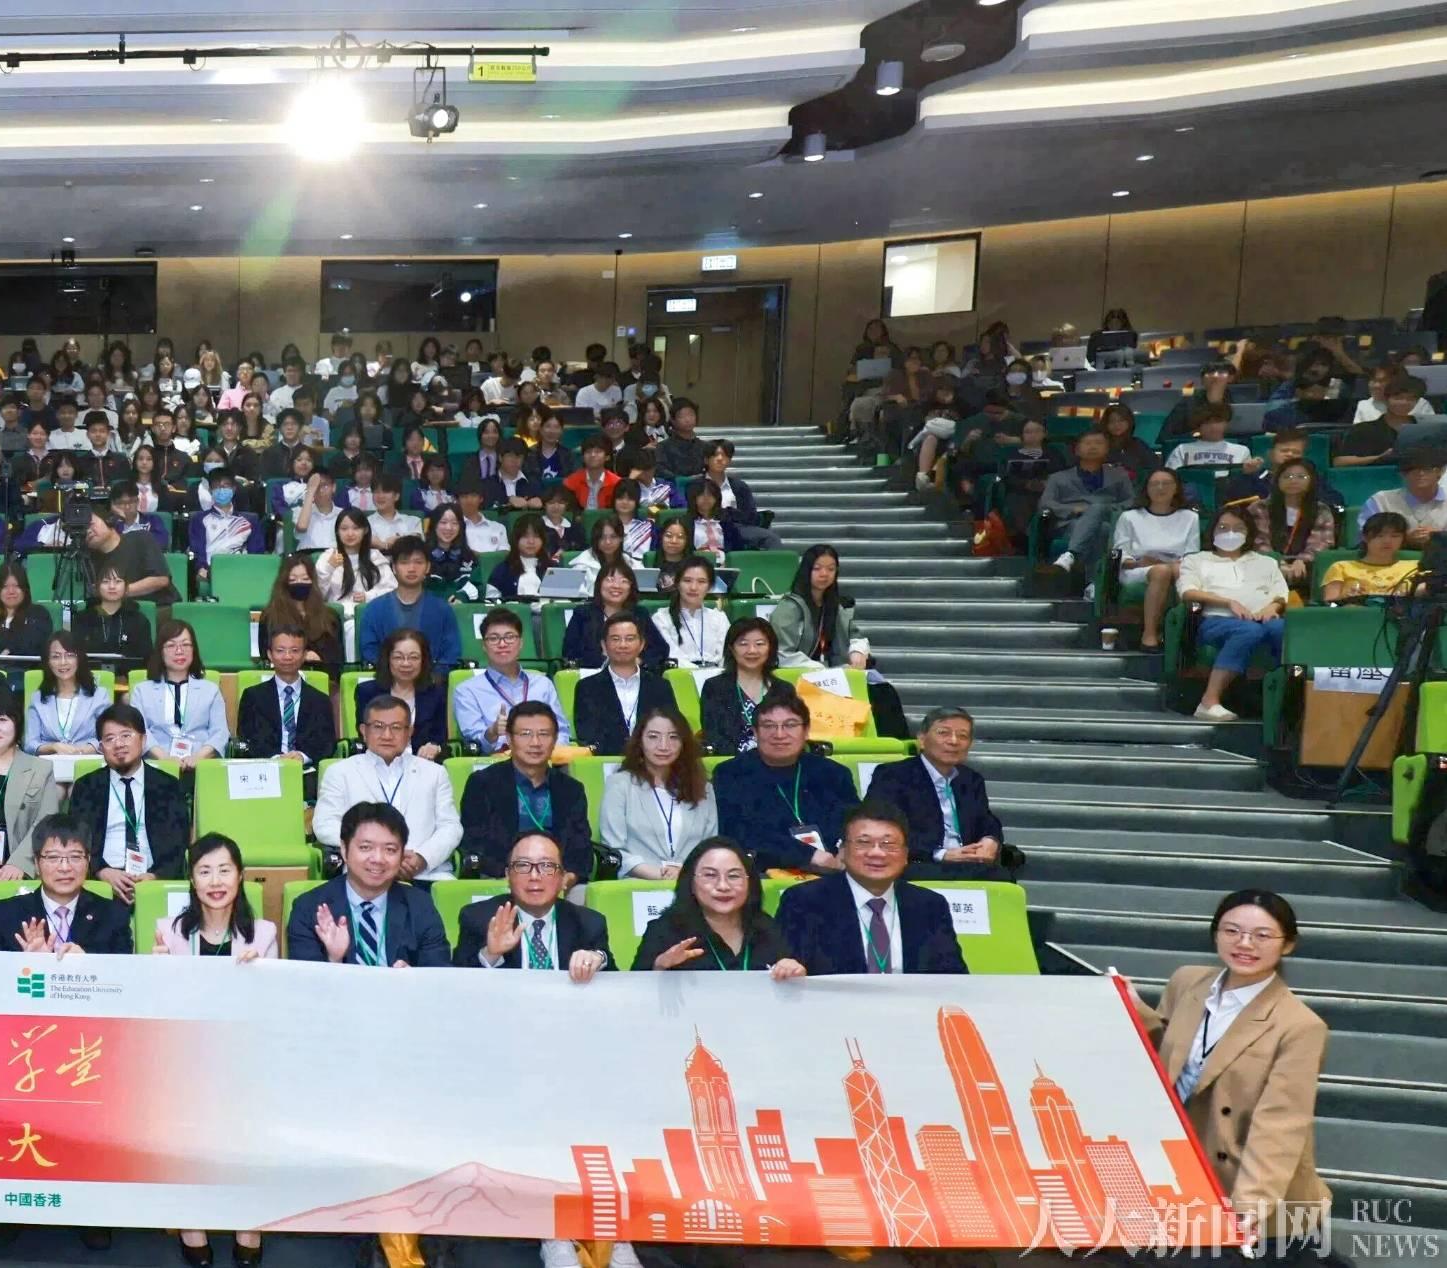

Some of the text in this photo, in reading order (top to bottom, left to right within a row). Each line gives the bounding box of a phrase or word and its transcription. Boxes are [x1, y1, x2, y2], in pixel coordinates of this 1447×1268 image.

[477, 65, 484, 77] 1
[50, 985, 123, 994] The Education University
[56, 993, 74, 1001] Hong
[74, 993, 91, 1002] Kong
[4, 1191, 63, 1208] 中國香港
